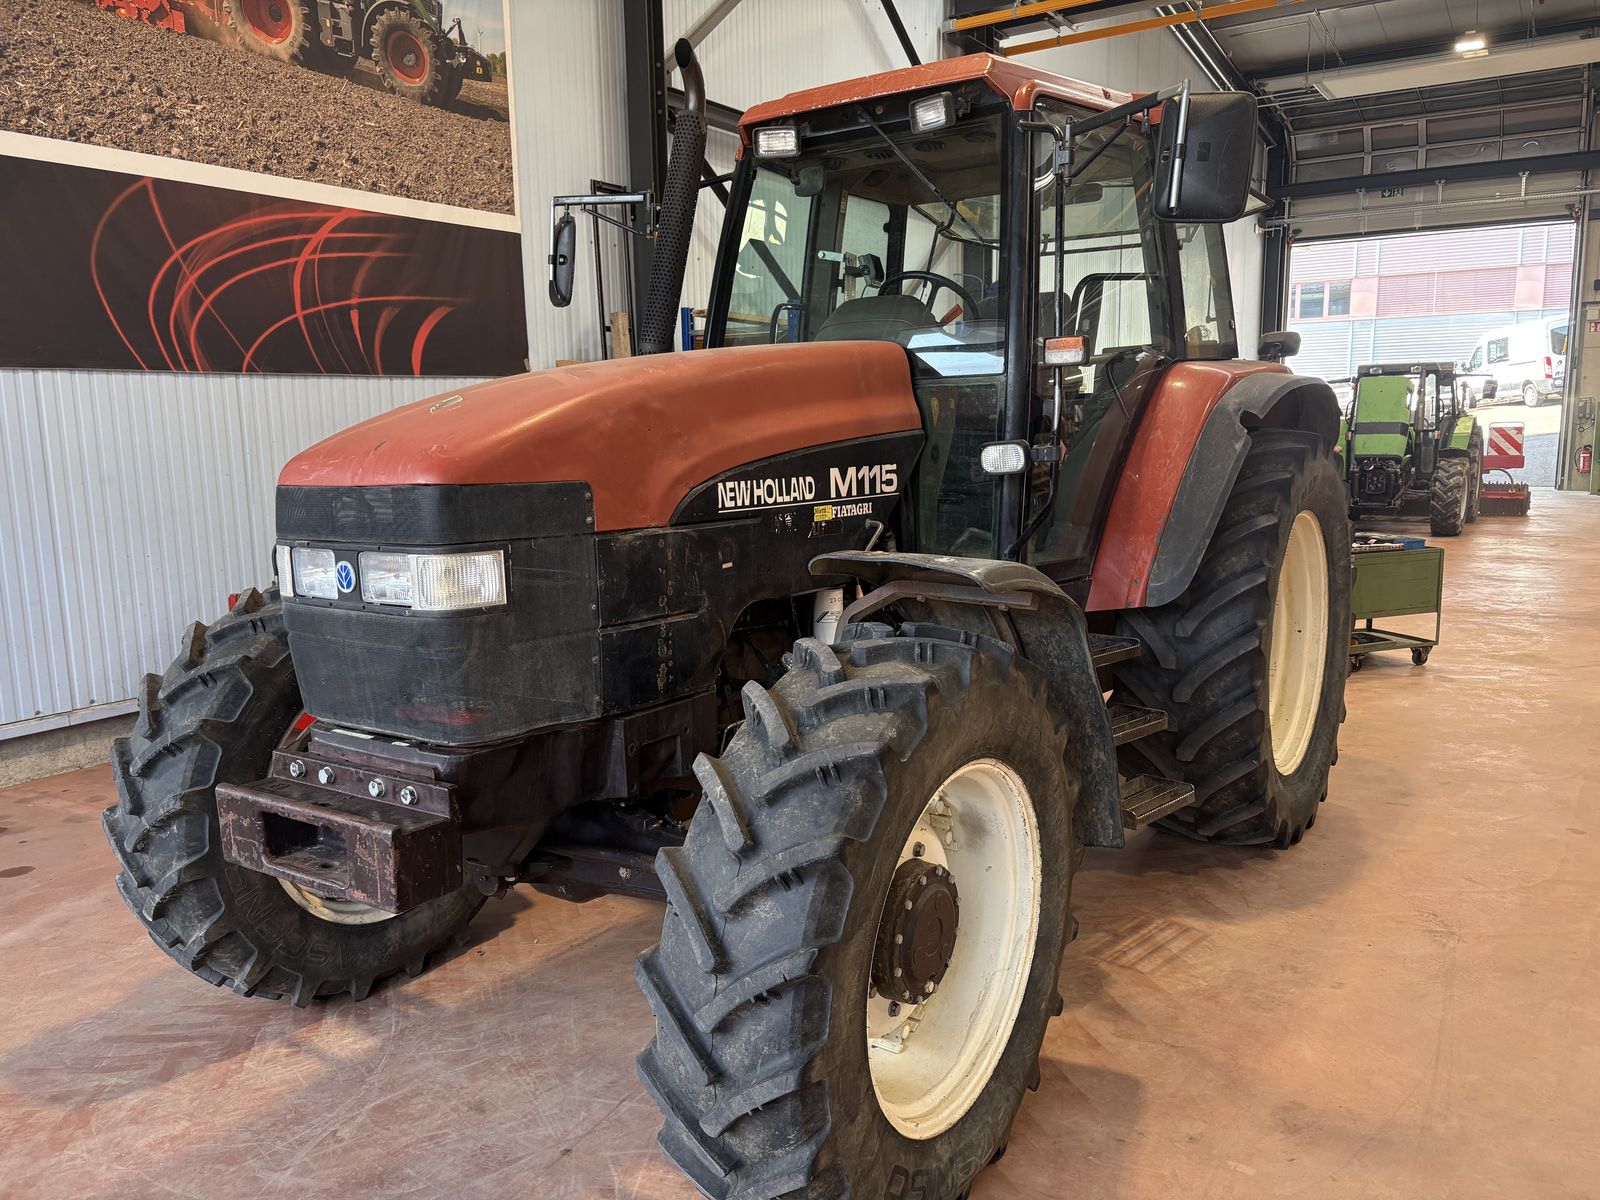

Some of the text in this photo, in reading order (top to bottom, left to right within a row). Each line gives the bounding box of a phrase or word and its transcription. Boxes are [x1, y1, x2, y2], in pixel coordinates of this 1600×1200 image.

[718, 476, 815, 509] NEW HOLLAND
[829, 463, 898, 499] M115
[832, 502, 873, 519] FIATAGRI
